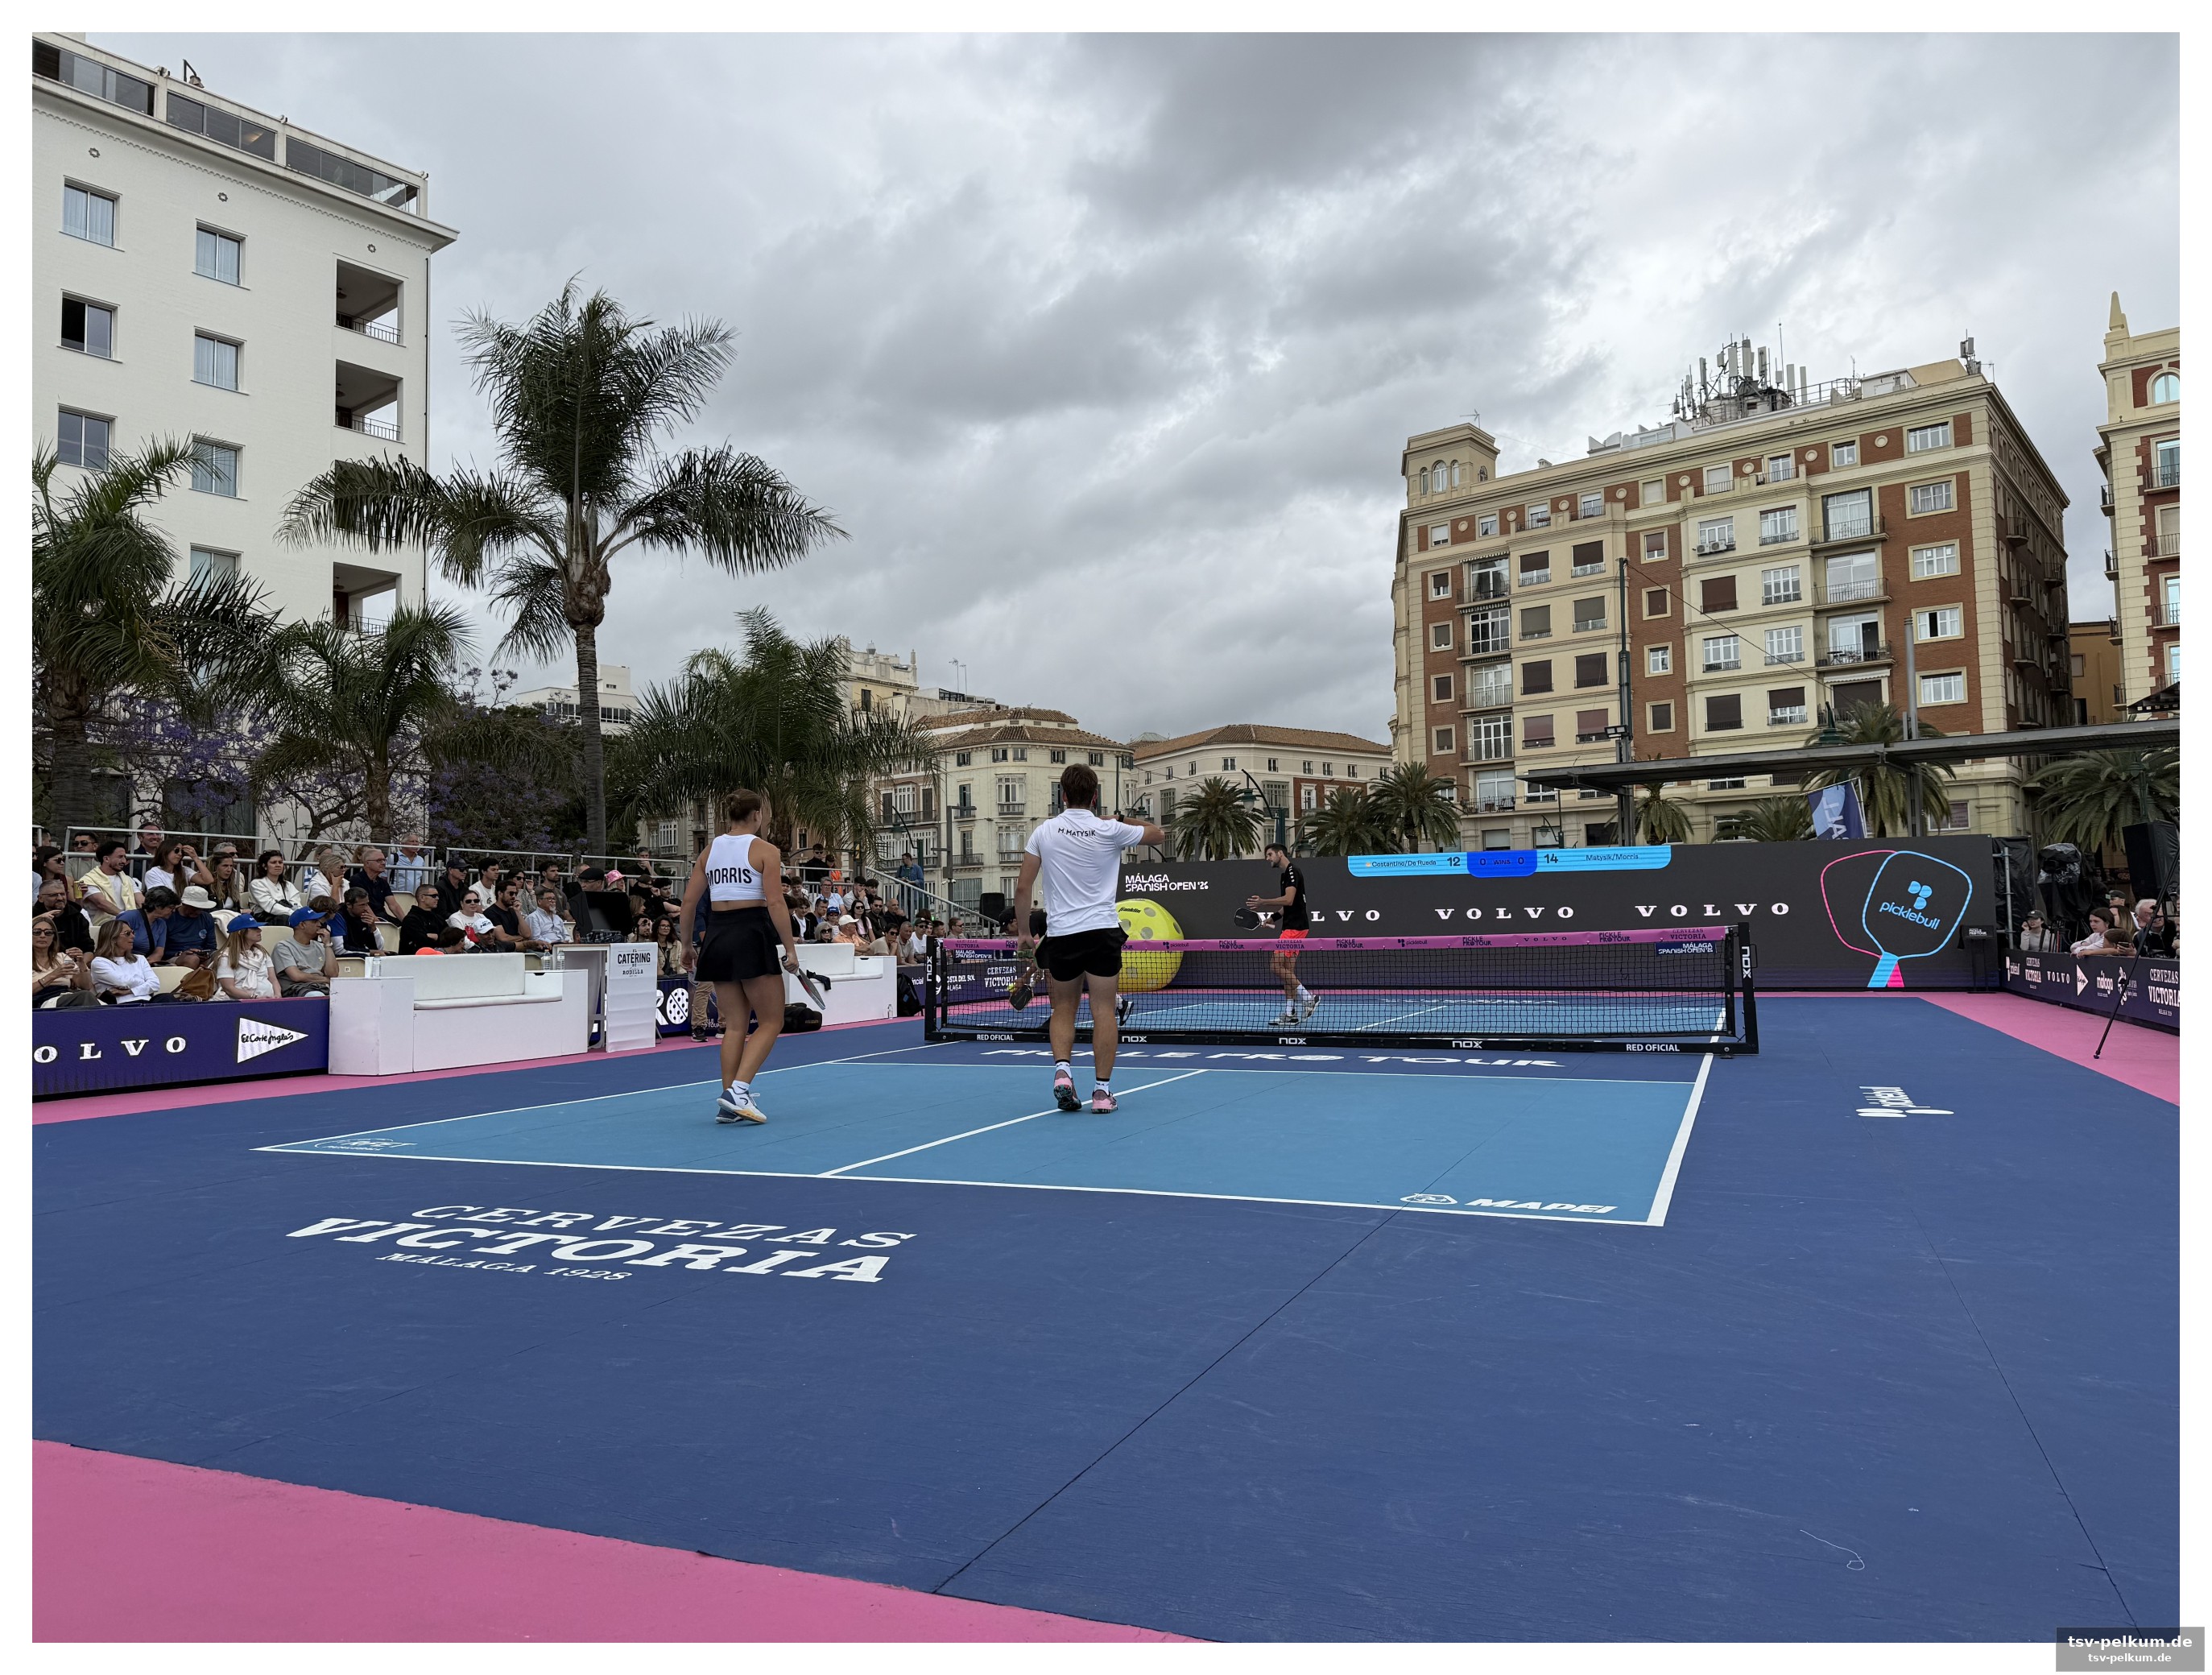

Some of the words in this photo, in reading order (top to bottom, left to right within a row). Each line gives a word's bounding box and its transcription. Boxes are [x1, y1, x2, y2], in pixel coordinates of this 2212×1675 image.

[1446, 856, 1461, 866] 12
[1479, 858, 1486, 866] 0
[1517, 857, 1524, 865] 0
[1544, 854, 1558, 864] 14
[707, 867, 752, 886] MORRIS
[1125, 872, 1170, 884] MÁLAGA
[1125, 883, 1168, 892] SPANISH
[1169, 881, 1197, 891] OPEN
[1257, 910, 1380, 924] VLVO
[1434, 906, 1574, 920] VOLVO
[1635, 903, 1789, 917] VOLVO
[1879, 902, 1941, 929] picklebull
[618, 953, 651, 964] CATERING
[987, 966, 1016, 975] CERVEZAS
[2025, 969, 2041, 983] VICTORIA
[2047, 970, 2070, 984] VOLVO
[2149, 968, 2179, 984] CERVEZAS
[958, 974, 966, 982] DEL
[241, 1033, 250, 1044] El
[250, 1033, 267, 1042] Corte
[267, 1030, 294, 1045] Inglés
[34, 1037, 187, 1064] OLVO
[1645, 1044, 1681, 1052] OFICIAL
[1205, 1053, 1344, 1061] PRO
[1358, 1056, 1566, 1067] TOUR
[1465, 1198, 1619, 1214] MAPEI
[410, 1205, 917, 1248] CERVEZAS
[285, 1218, 891, 1283] VICTORIA
[544, 1267, 633, 1281] 1928
